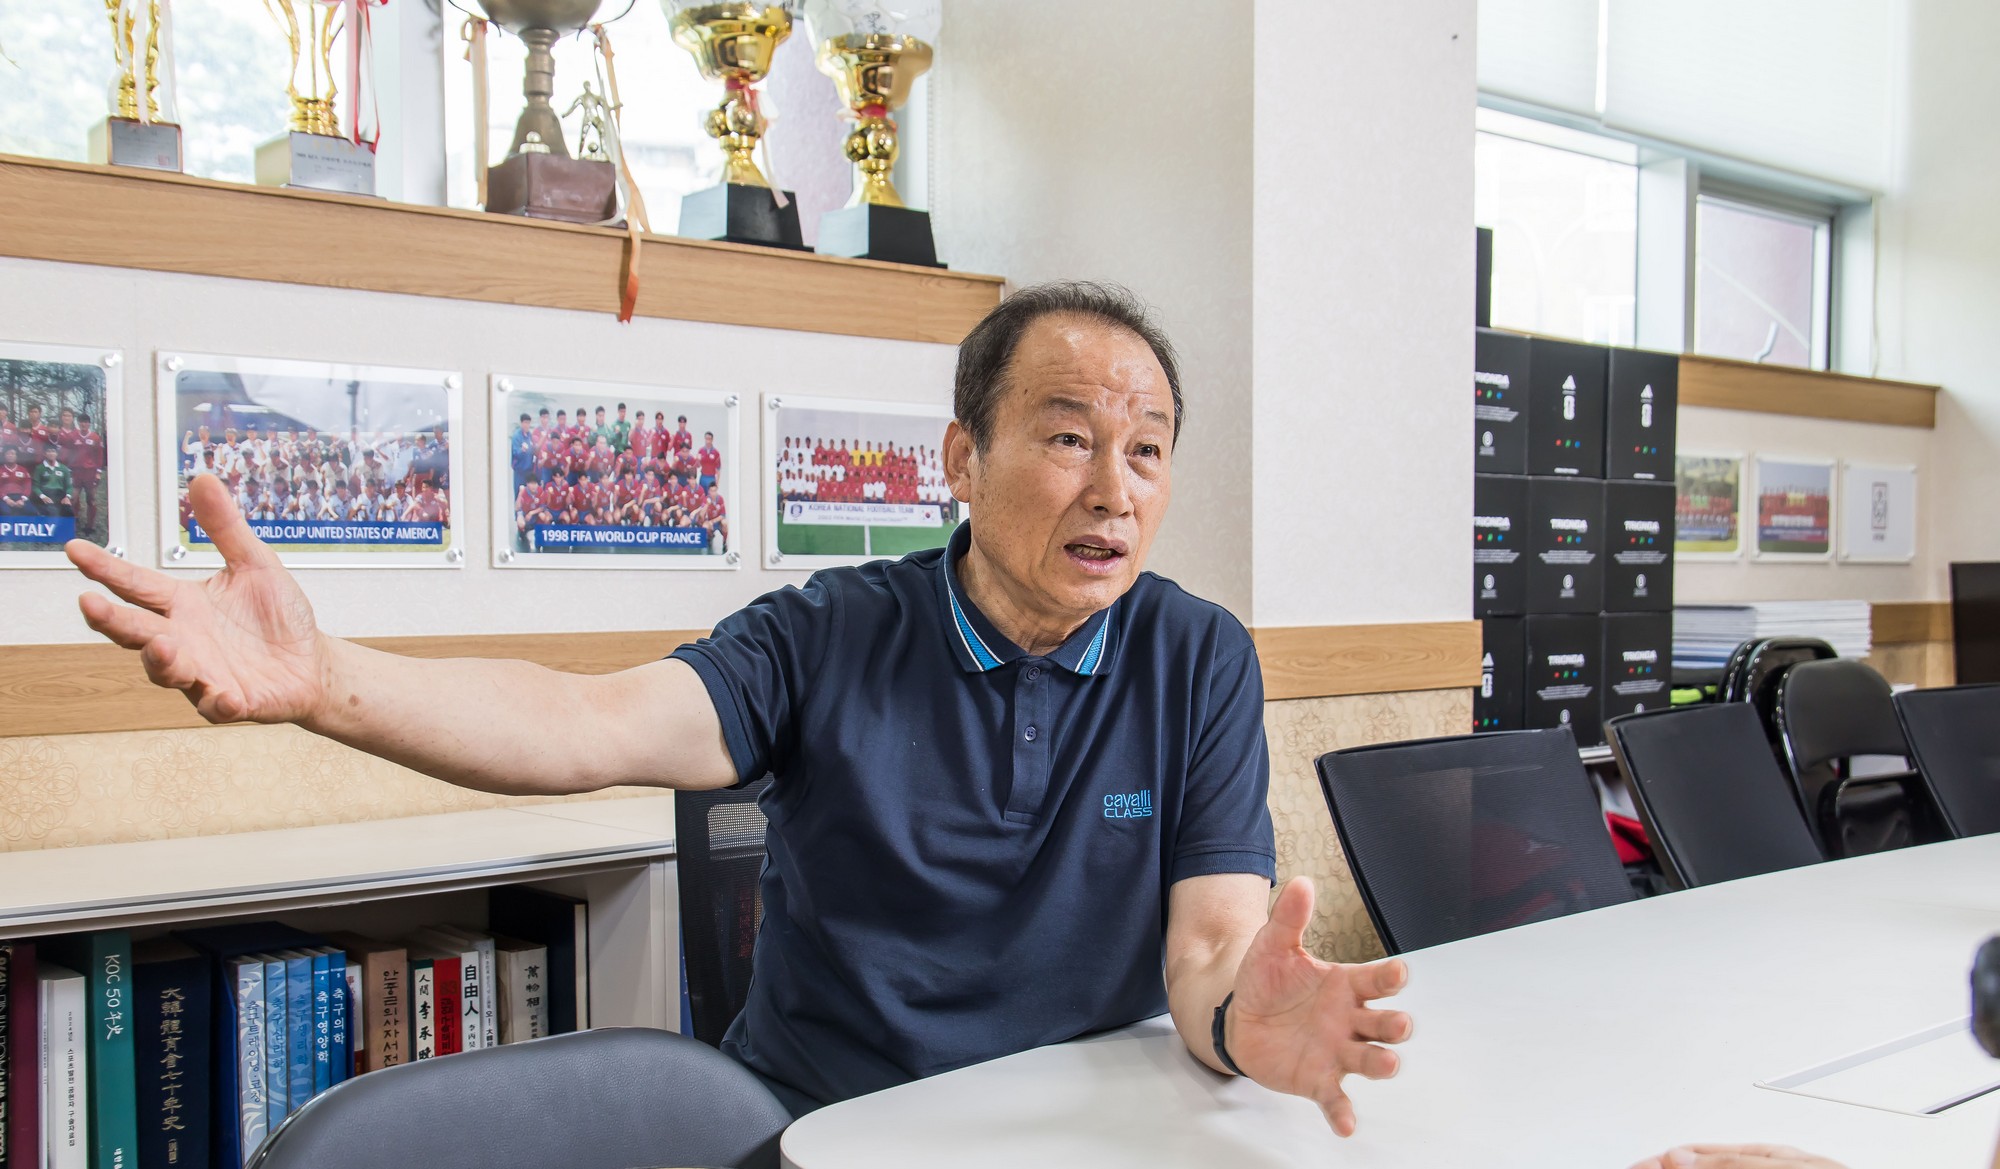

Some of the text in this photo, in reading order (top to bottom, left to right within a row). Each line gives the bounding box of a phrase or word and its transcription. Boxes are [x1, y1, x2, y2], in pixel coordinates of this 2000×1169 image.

[14, 523, 55, 537] ITALY
[285, 526, 305, 539] CUP
[307, 526, 343, 540] UNITED
[345, 527, 380, 540] STATES
[381, 527, 394, 540] OF
[396, 527, 439, 540] AMERICA
[542, 529, 701, 544] 1998 FIFA WORLD CUP FRANCE
[1104, 790, 1151, 808] cavalli
[1104, 807, 1152, 818] CLASS
[104, 954, 121, 984] KOC
[464, 964, 479, 1016] 自由人
[332, 987, 345, 1045] 축구의학
[316, 990, 329, 1064] 축구영양학
